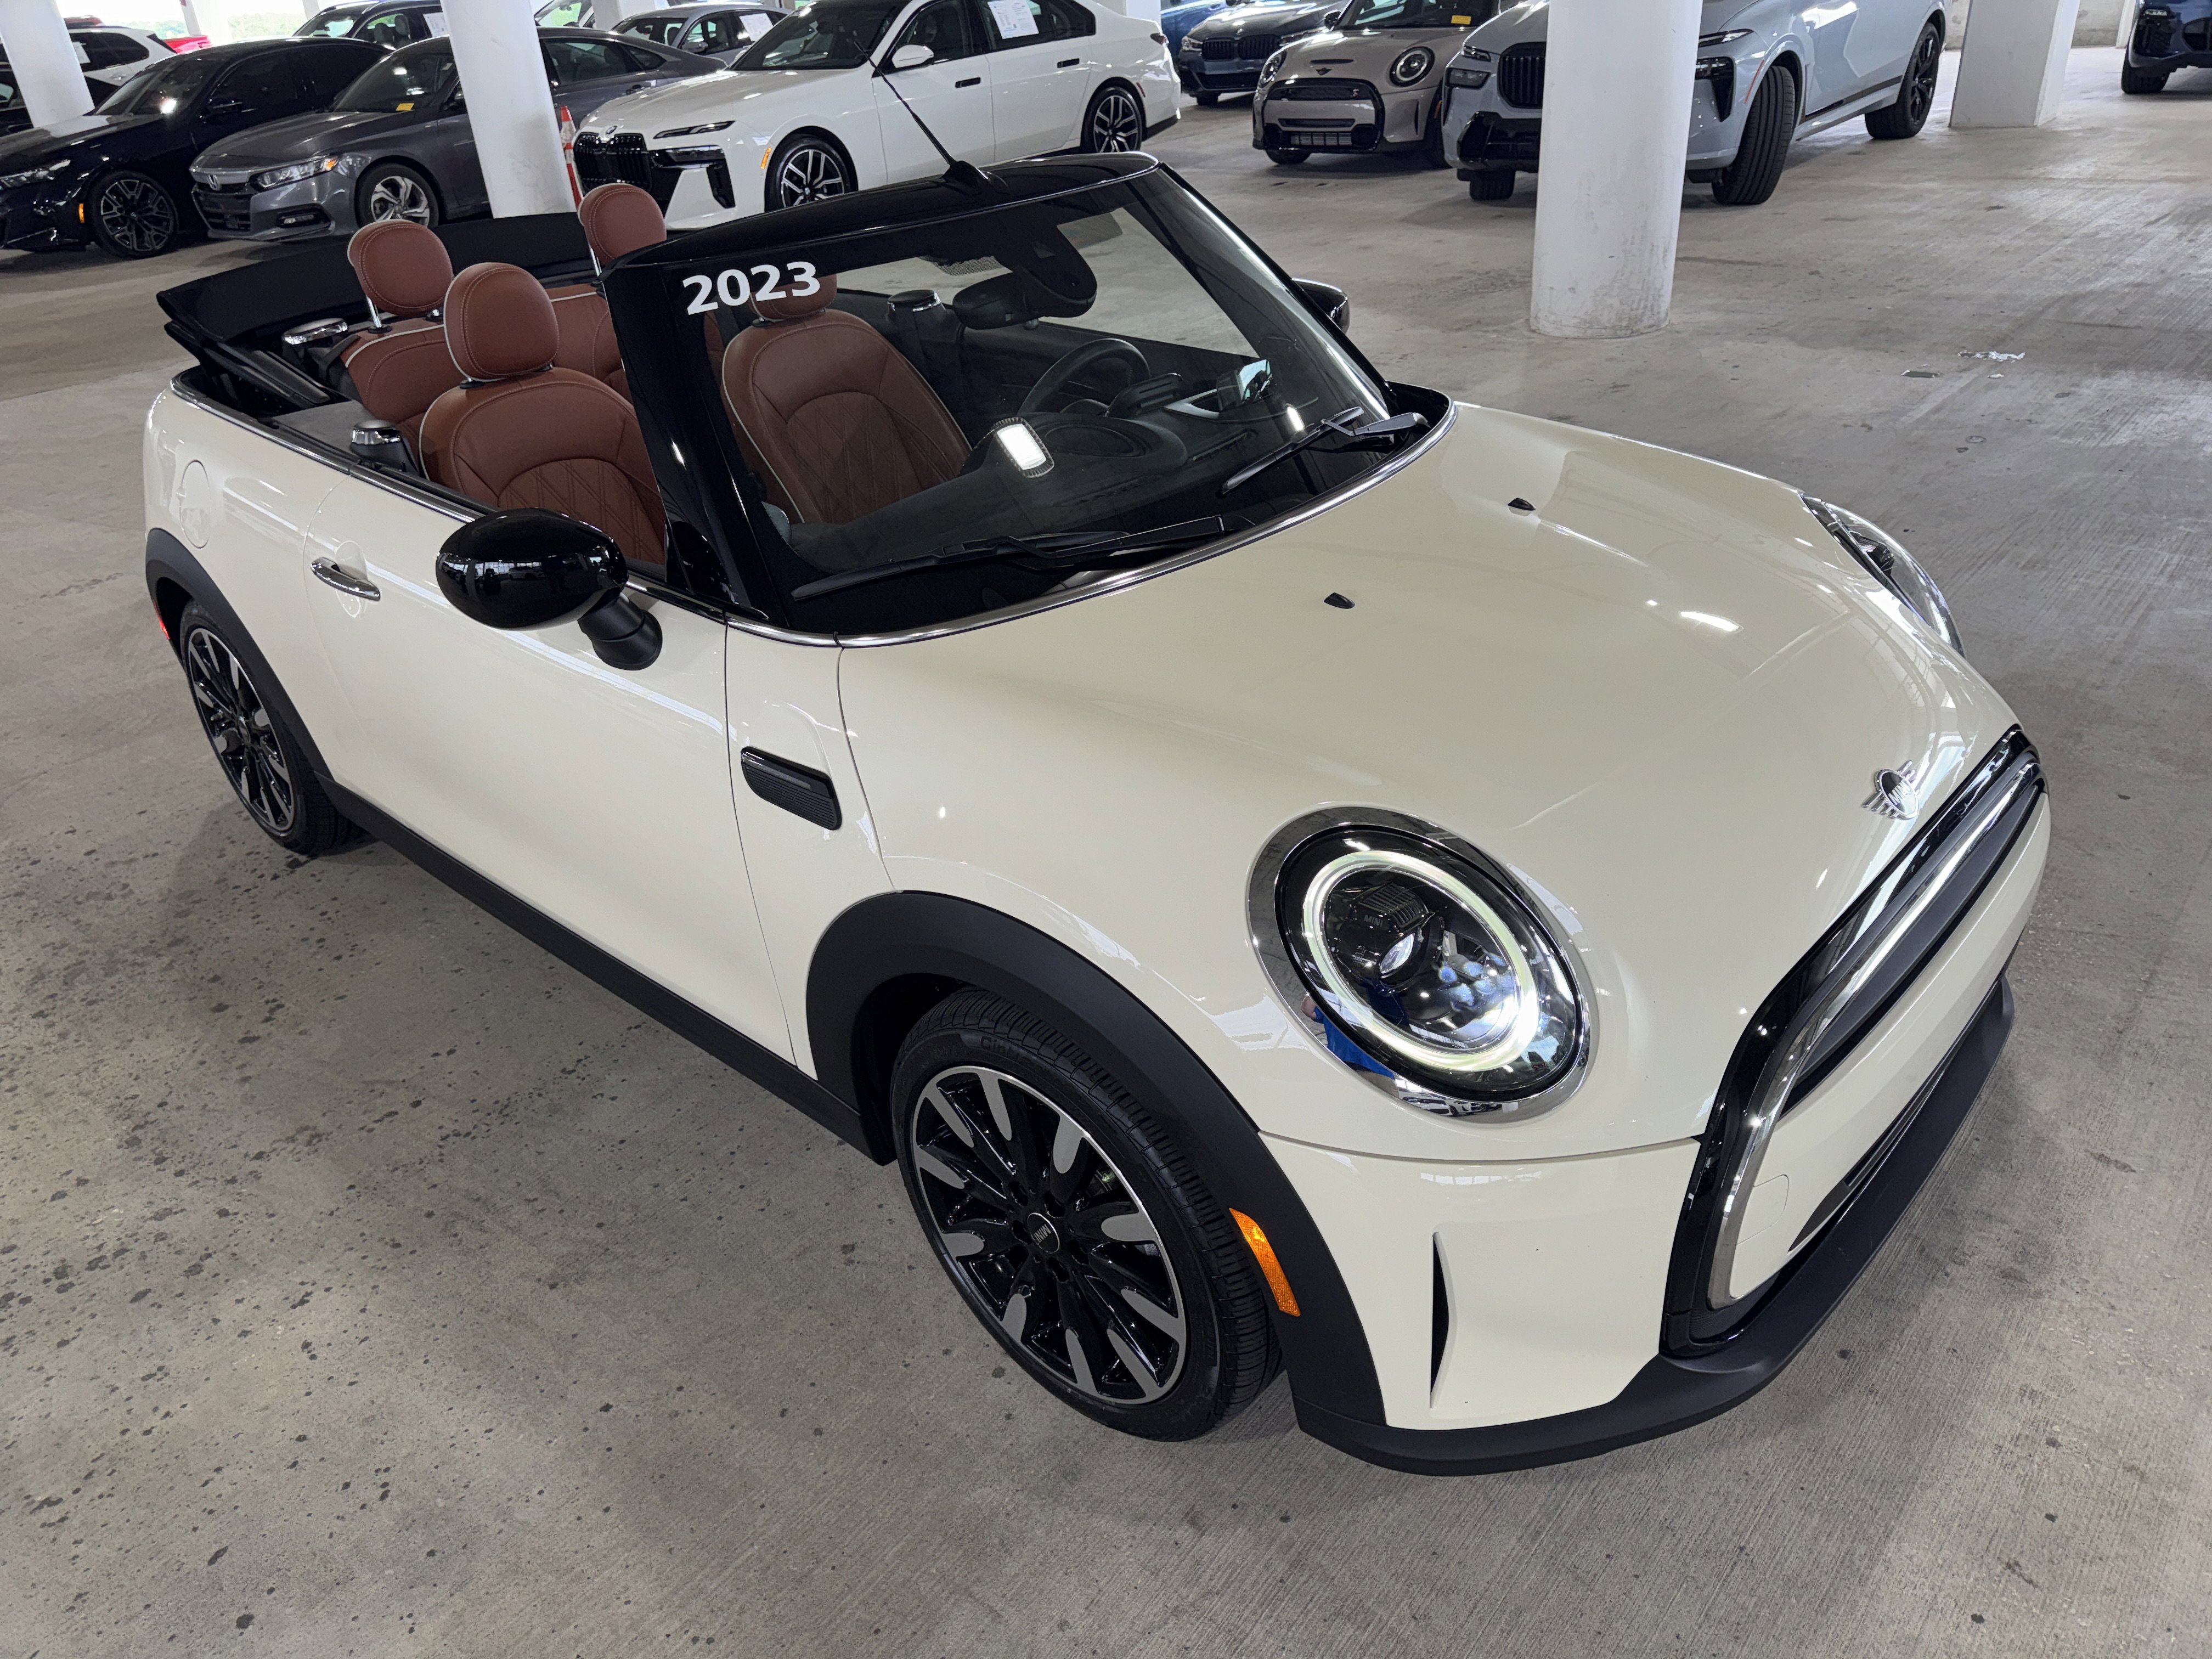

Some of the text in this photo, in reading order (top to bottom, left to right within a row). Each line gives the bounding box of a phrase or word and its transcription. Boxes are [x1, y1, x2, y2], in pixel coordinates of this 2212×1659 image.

[682, 261, 821, 315] 2023
[1887, 778, 1911, 805] MINI
[1363, 915, 1383, 927] MINI
[1034, 1224, 1052, 1243] MINI
